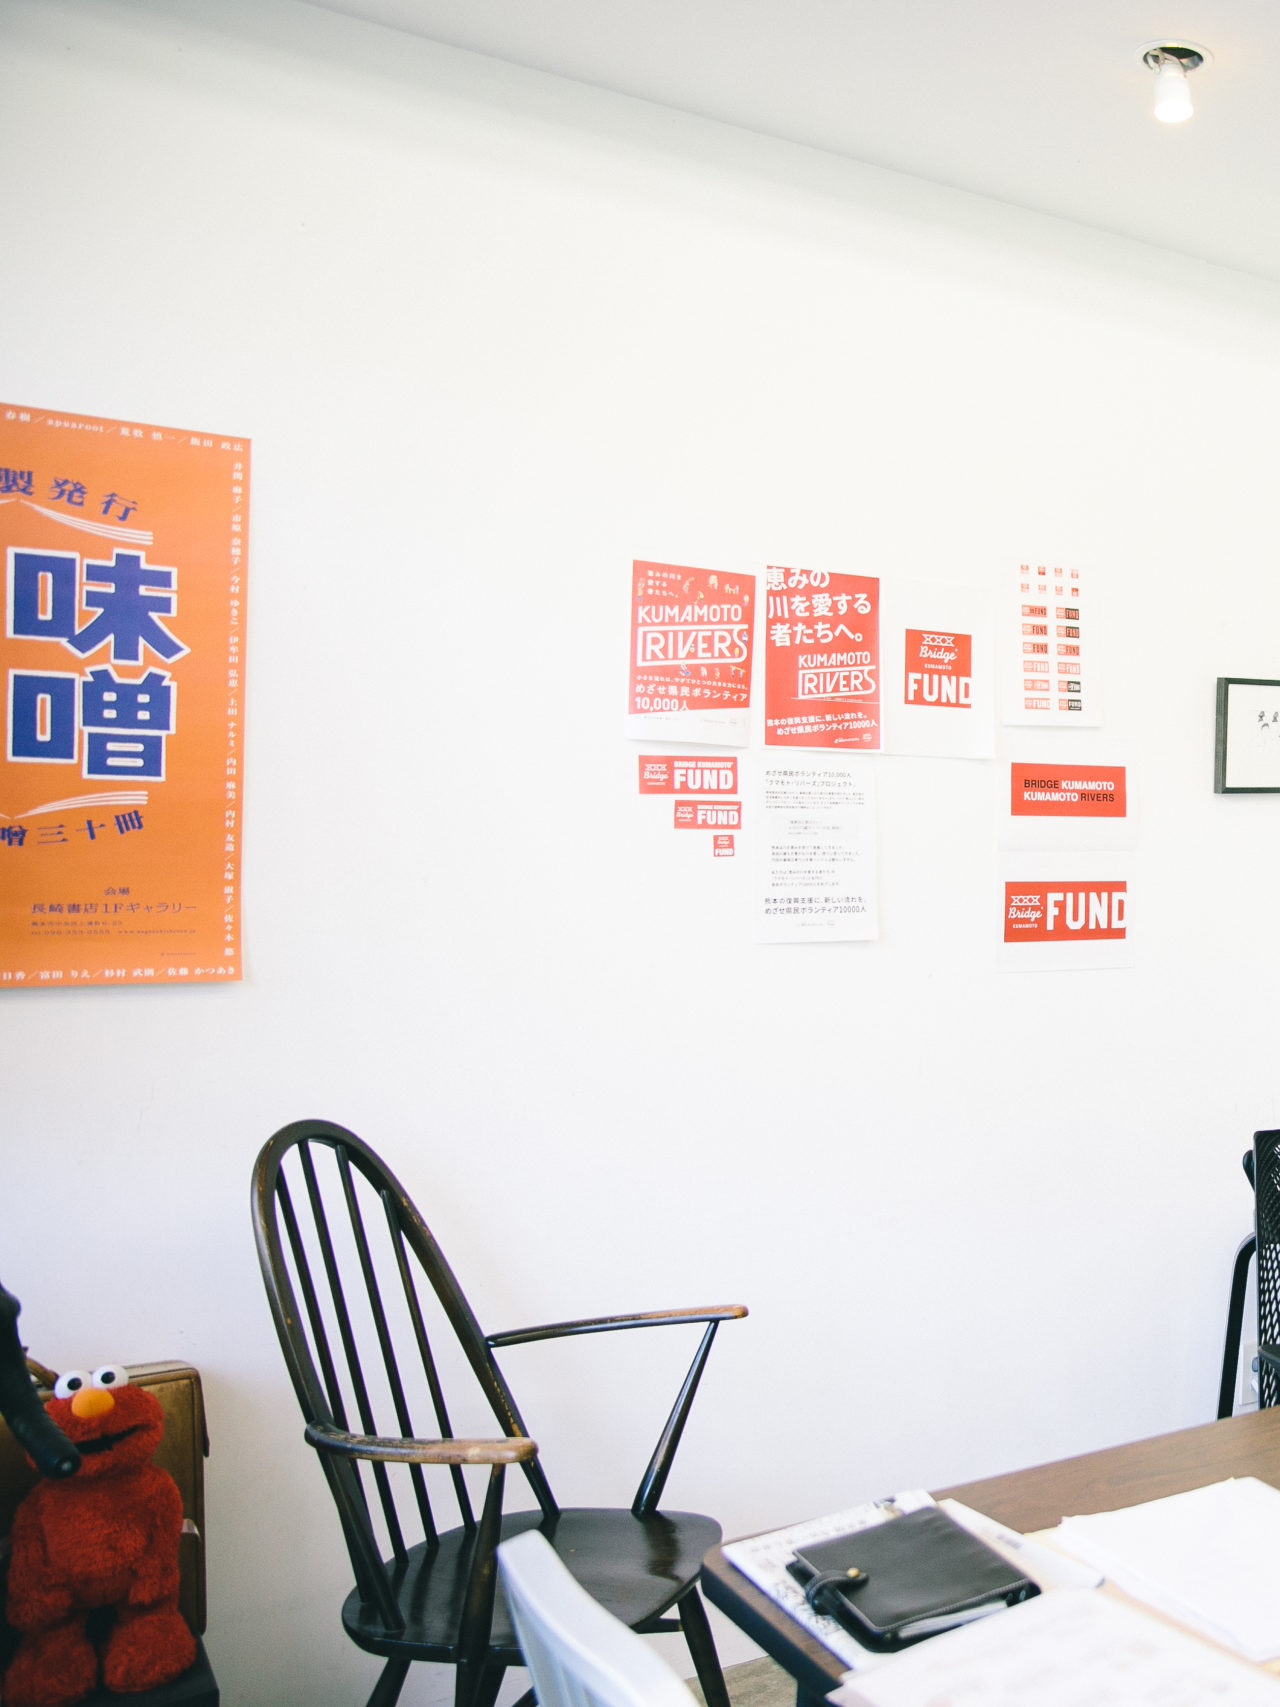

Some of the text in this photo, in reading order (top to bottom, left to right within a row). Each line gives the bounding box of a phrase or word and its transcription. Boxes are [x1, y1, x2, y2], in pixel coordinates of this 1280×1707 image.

[766, 567, 830, 590] 恵みの
[638, 604, 742, 623] KUMAMOTO
[768, 592, 871, 619] 川を愛する
[770, 622, 863, 647] 者たちへ。
[641, 625, 748, 664] RIVERS
[919, 645, 958, 663] Bridge
[799, 651, 870, 667] KUMAMOTO
[802, 668, 876, 696] RIVERS
[908, 672, 971, 705] FUND
[635, 684, 747, 702] めざせ県民ボランティア
[635, 696, 689, 711] 10,000人
[674, 768, 734, 790] FUND
[1024, 779, 1115, 790] BRIDGE KUMAMOTO
[1024, 791, 1114, 802] KUMAMOTO RIVERS
[697, 810, 739, 825] FUND
[1008, 907, 1043, 921] Bridge
[1047, 891, 1127, 931] FUND
